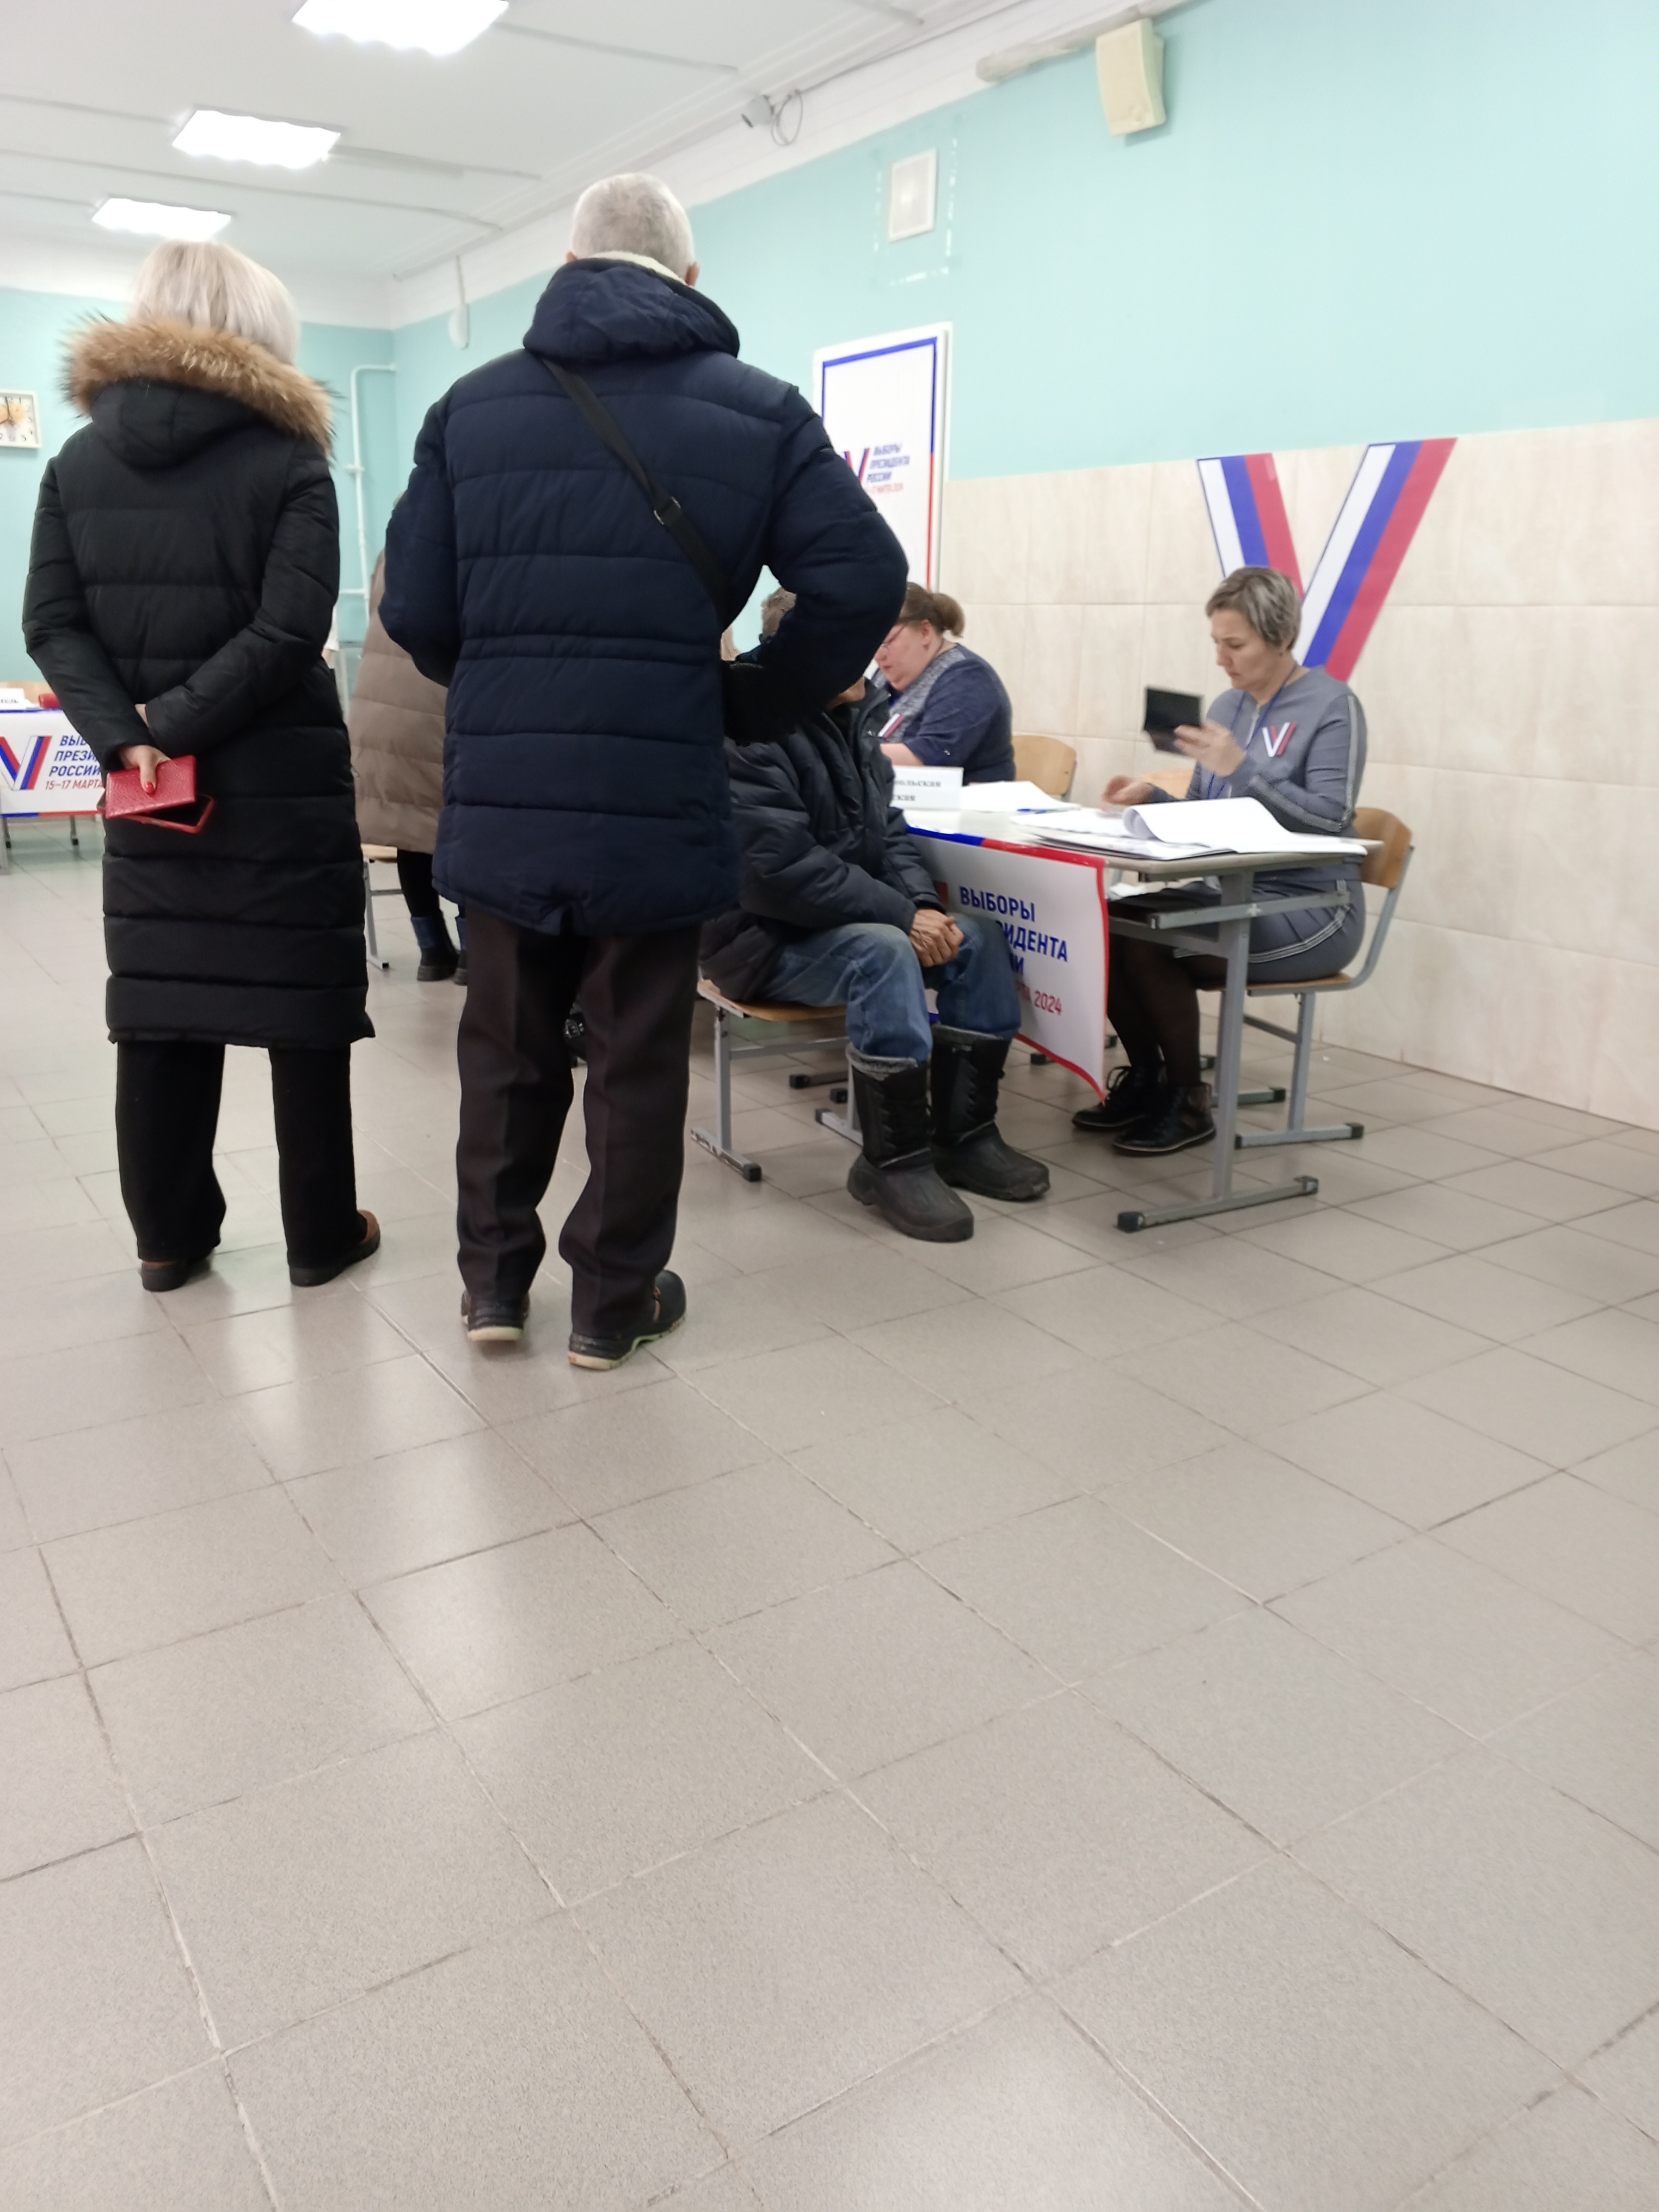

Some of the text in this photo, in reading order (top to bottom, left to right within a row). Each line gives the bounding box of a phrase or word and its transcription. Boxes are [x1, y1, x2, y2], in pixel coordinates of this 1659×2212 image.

[59, 735, 87, 746] ВЫБ
[54, 750, 97, 762] ПРЕЗИ
[49, 765, 101, 777] РОССИИ
[960, 886, 1035, 922] ВЫБОРЫ
[996, 920, 1068, 962] ИДЕНТА
[1035, 990, 1062, 1016] 2024
